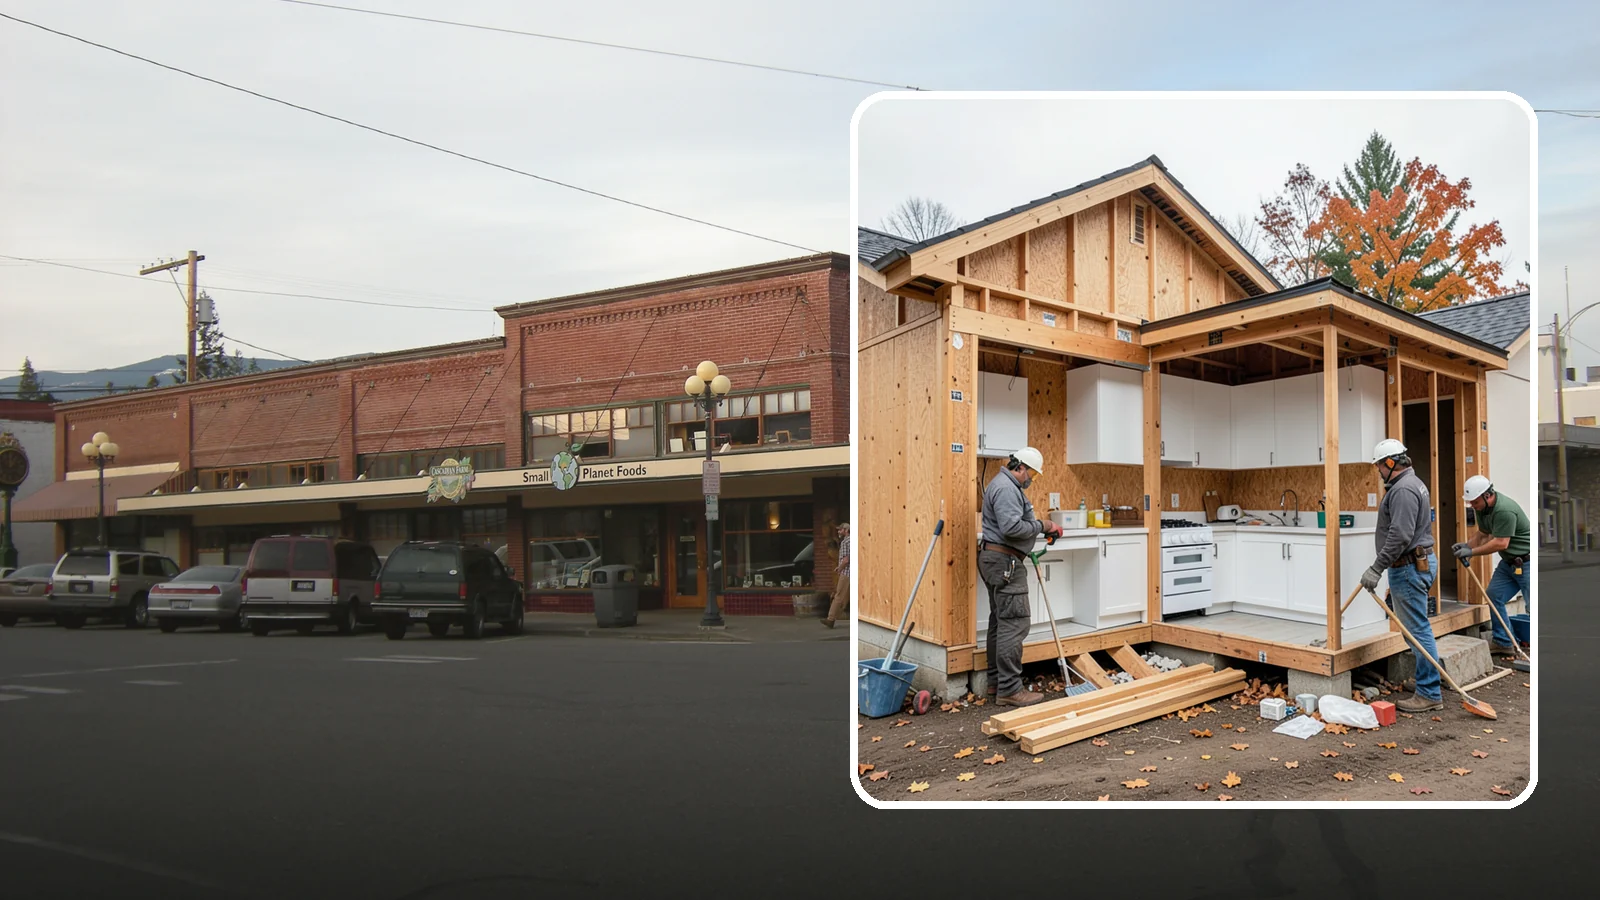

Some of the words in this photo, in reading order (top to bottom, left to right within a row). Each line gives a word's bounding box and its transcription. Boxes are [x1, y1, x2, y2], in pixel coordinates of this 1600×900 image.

[523, 471, 549, 483] Small
[583, 467, 614, 479] Planet
[617, 464, 647, 477] Foods
